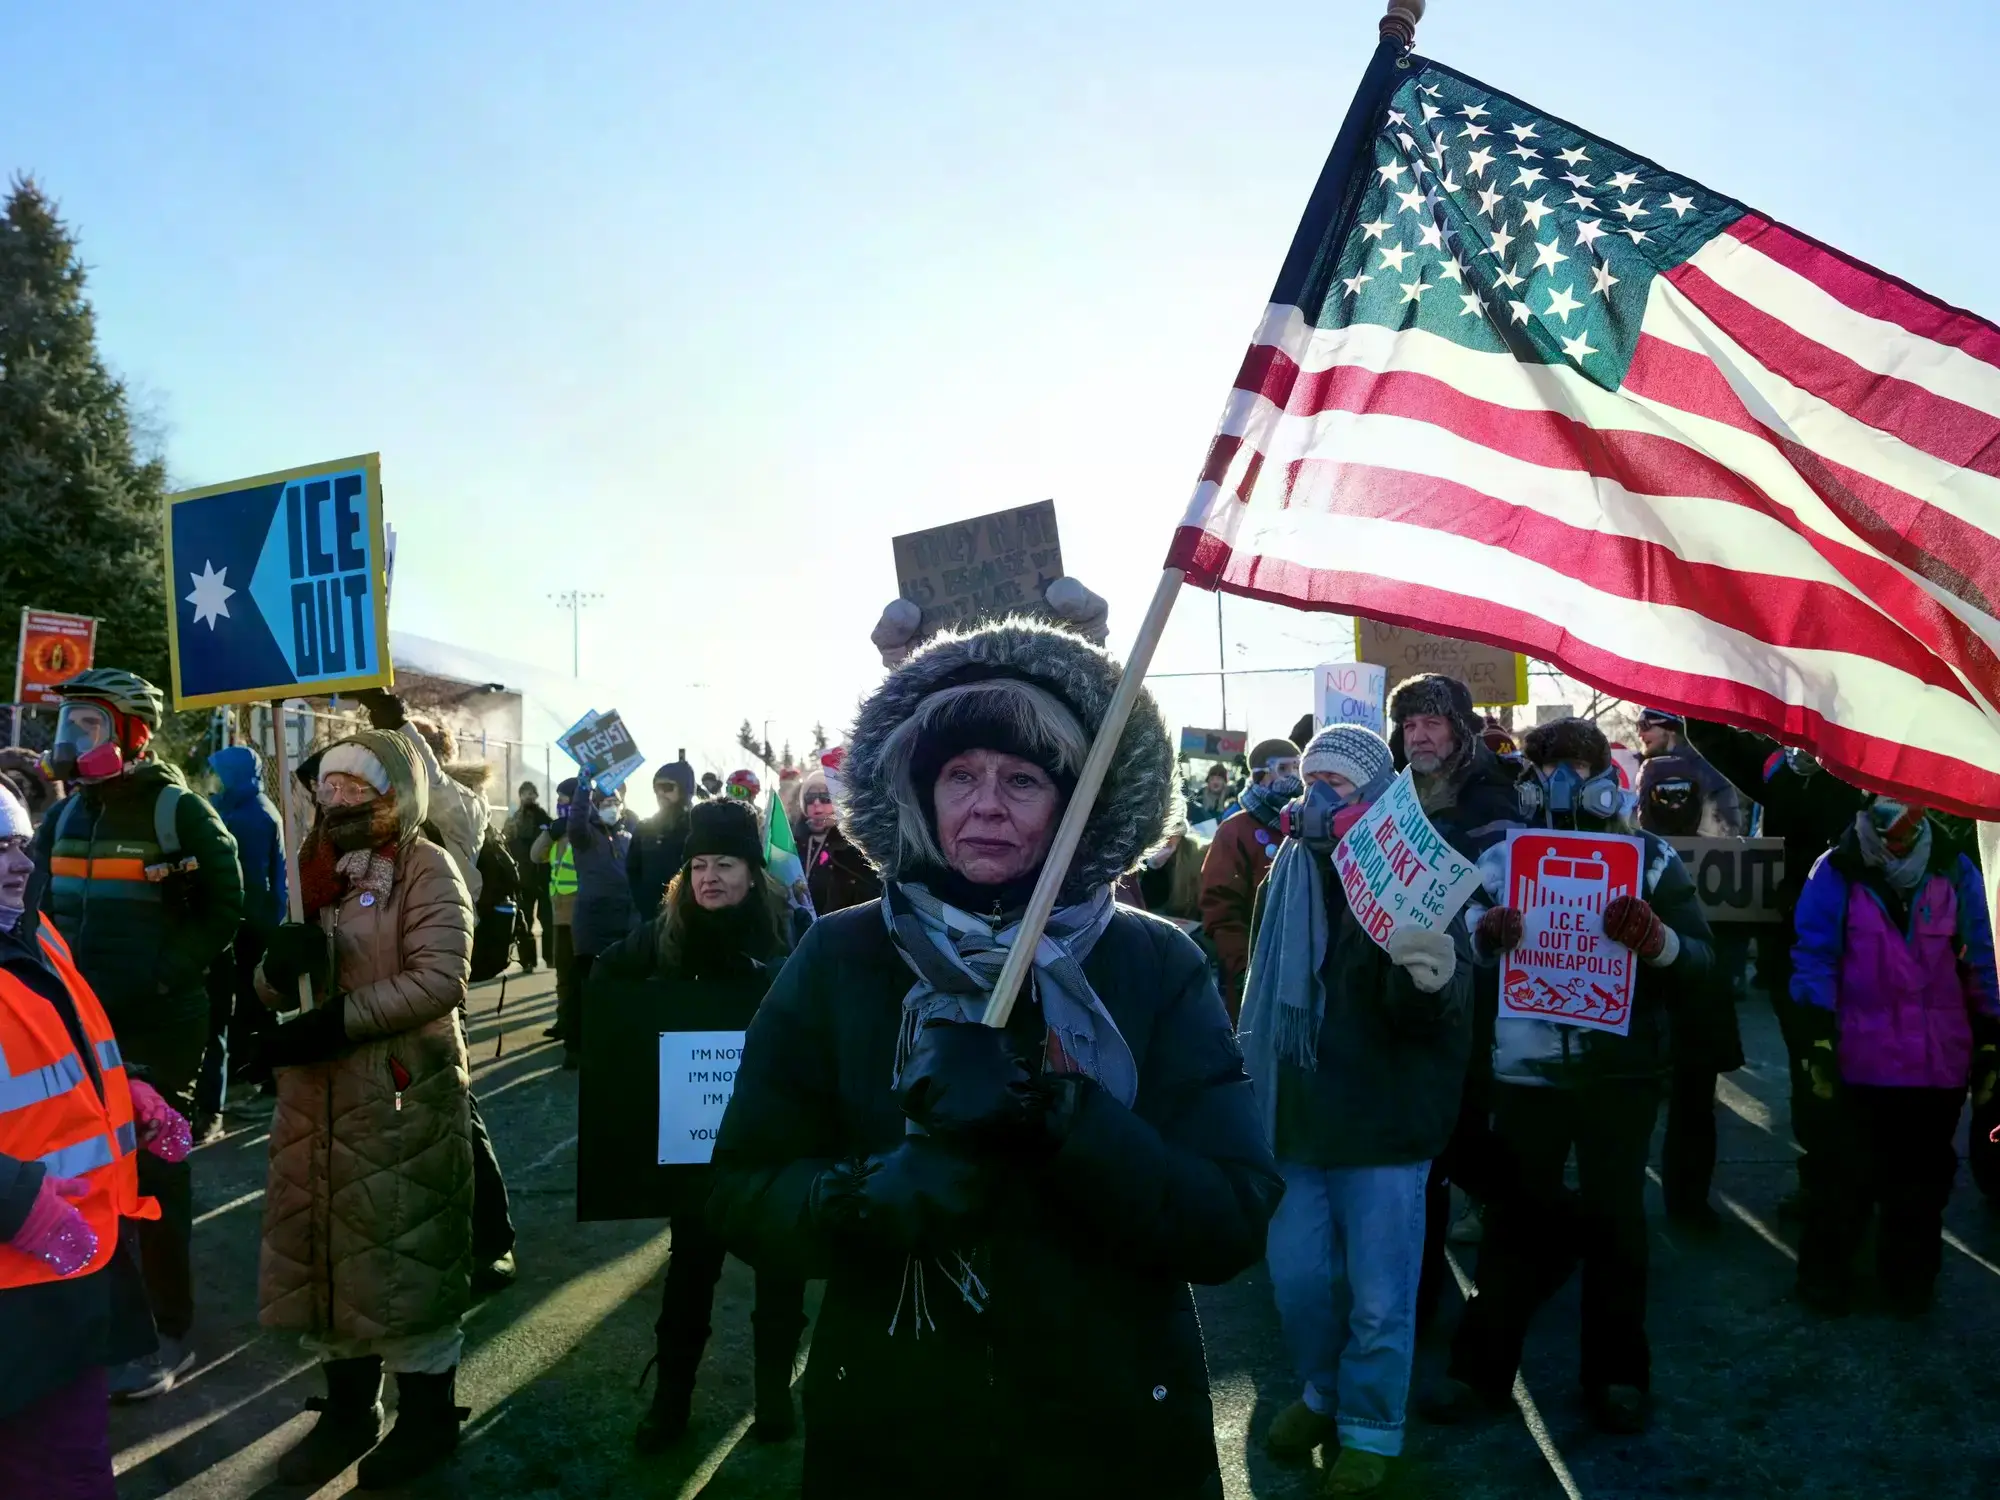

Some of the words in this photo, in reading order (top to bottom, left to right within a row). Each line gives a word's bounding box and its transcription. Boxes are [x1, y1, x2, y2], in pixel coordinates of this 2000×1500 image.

[286, 474, 366, 579] ICE
[290, 573, 367, 677] OUT
[1326, 669, 1357, 692] NO
[1341, 697, 1377, 720] ONLY
[574, 720, 629, 763] RESIST
[1375, 815, 1427, 888] HEART
[1400, 804, 1451, 871] SHAPE
[1450, 863, 1473, 886] of
[1350, 818, 1393, 899] SHADOW
[1394, 893, 1409, 911] of
[1410, 906, 1434, 929] my
[1421, 892, 1445, 916] the
[1549, 912, 1590, 932] I.C.E.
[1539, 931, 1572, 950] OUT
[1577, 935, 1600, 953] OF
[1514, 949, 1623, 976] MINNEAPOLIS
[712, 1071, 737, 1082] NO
